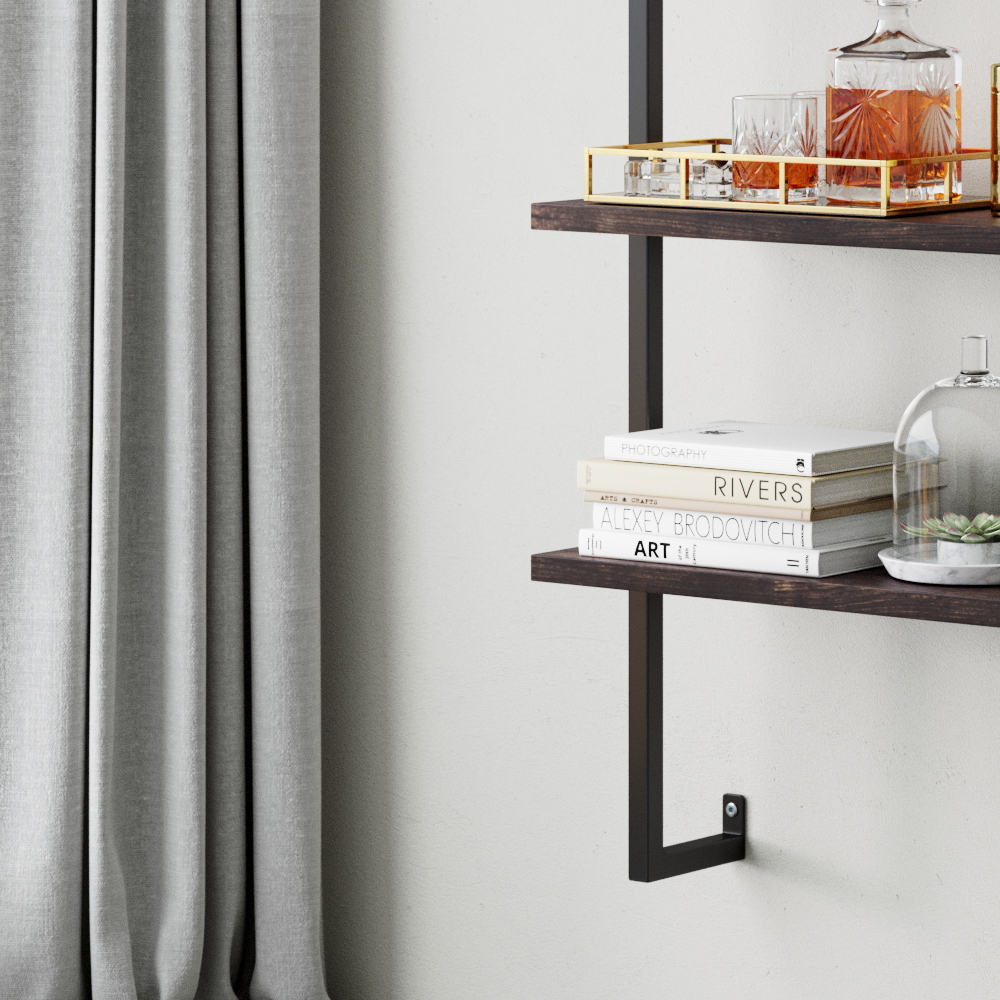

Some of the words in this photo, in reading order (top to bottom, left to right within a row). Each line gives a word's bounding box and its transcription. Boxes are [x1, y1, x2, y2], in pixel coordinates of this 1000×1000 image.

[621, 443, 707, 460] PHOTOGRAPHY
[714, 476, 803, 503] RIVERS
[631, 497, 658, 505] CRAFTS
[600, 507, 664, 534] ALEXEY
[674, 512, 795, 546] BRODOVITCH
[634, 540, 670, 559] ART
